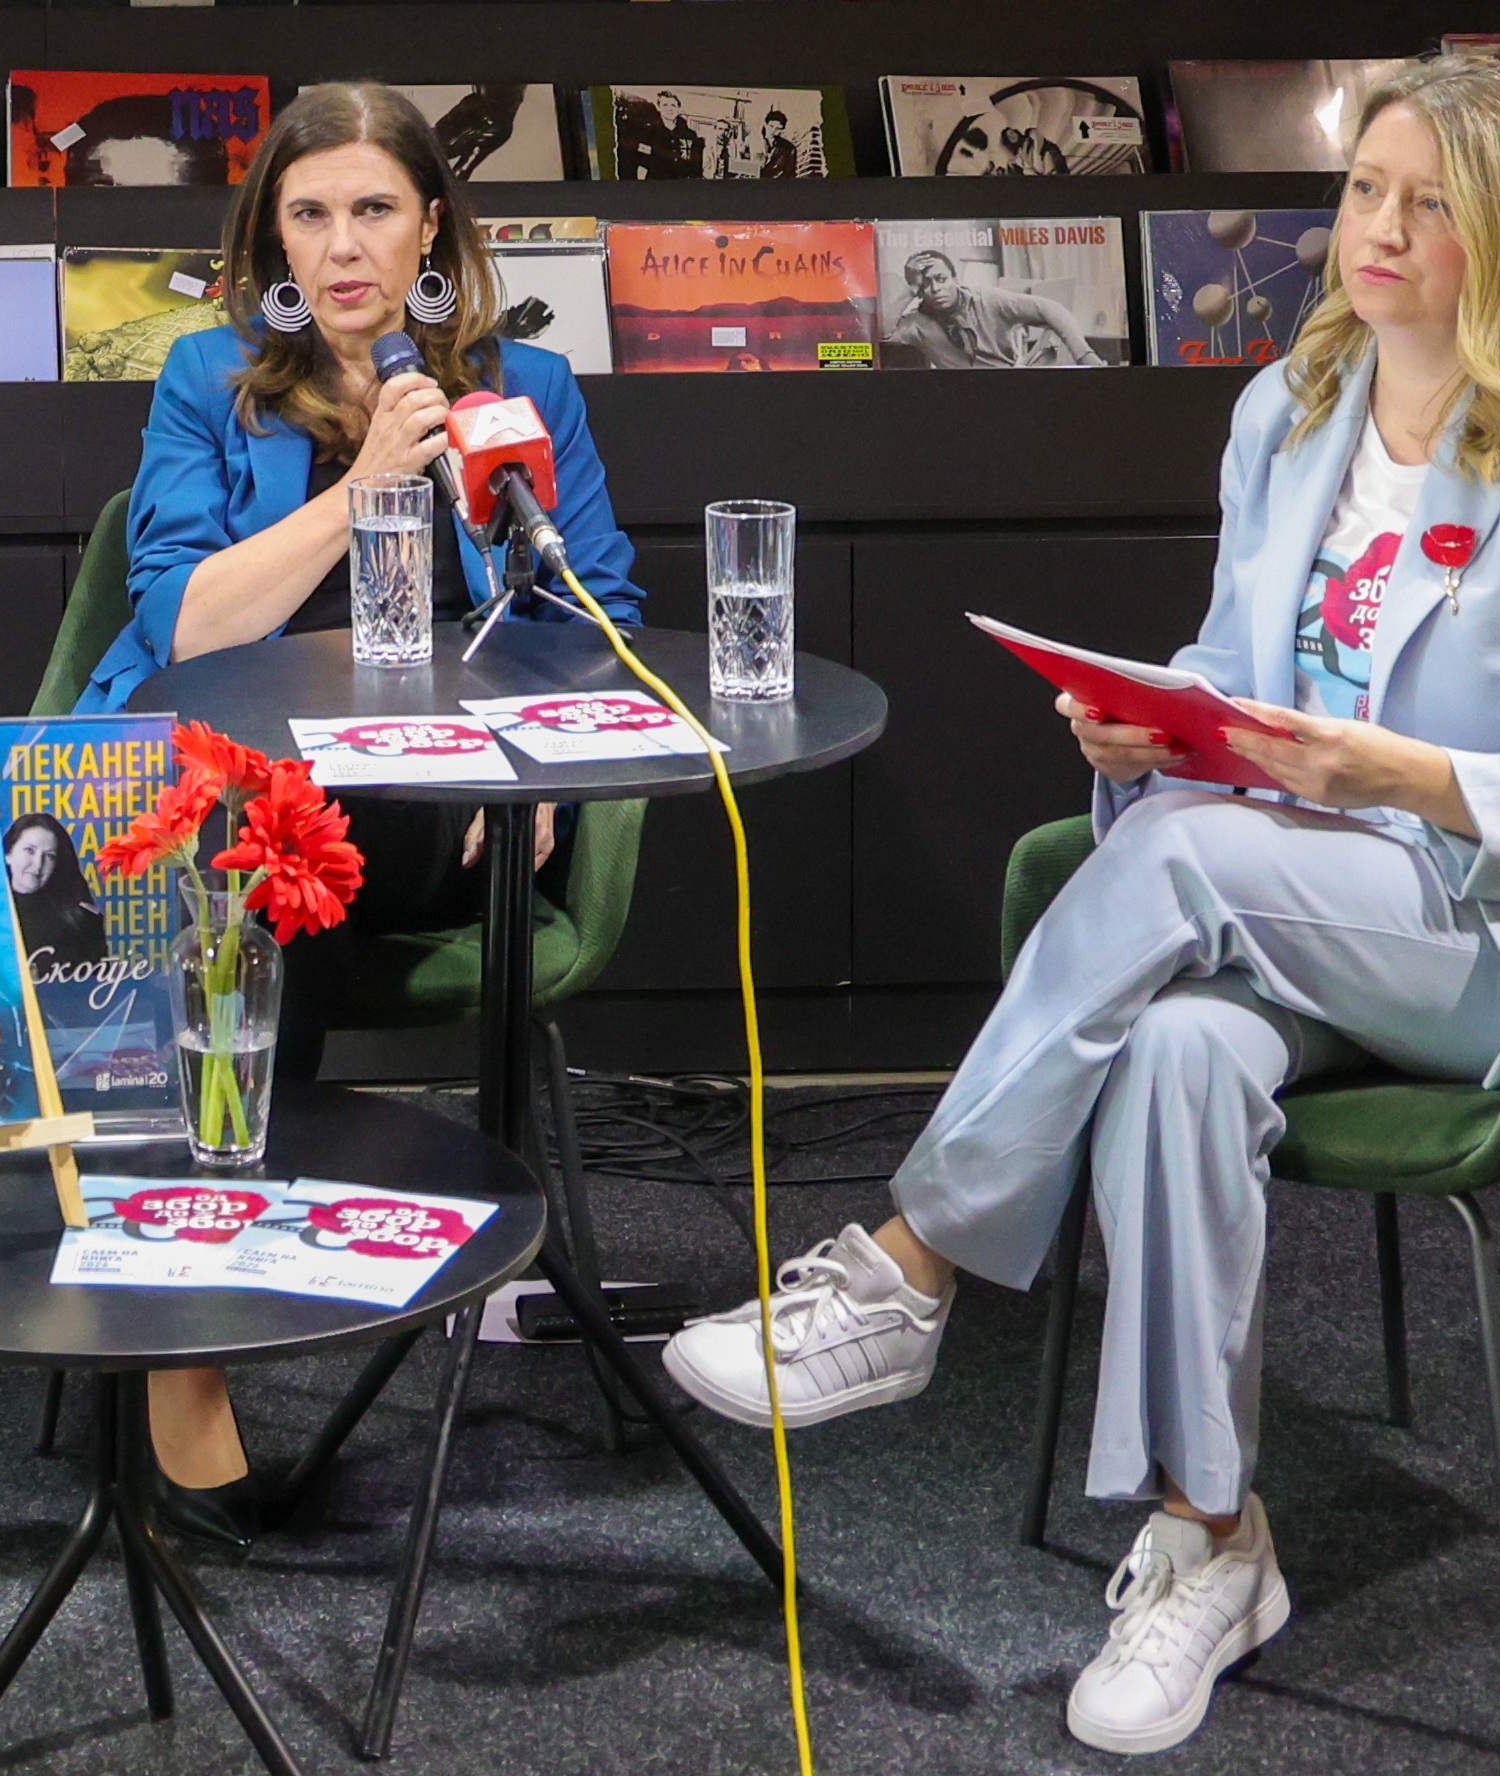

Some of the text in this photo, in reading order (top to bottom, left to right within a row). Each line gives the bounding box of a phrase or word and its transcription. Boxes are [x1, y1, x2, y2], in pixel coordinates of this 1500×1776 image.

[912, 226, 993, 247] Essential
[1000, 227, 1049, 246] MILES
[1054, 226, 1106, 245] DAVIS
[10, 739, 165, 782] ПЕКАНЕН
[148, 1071, 169, 1085] 20
